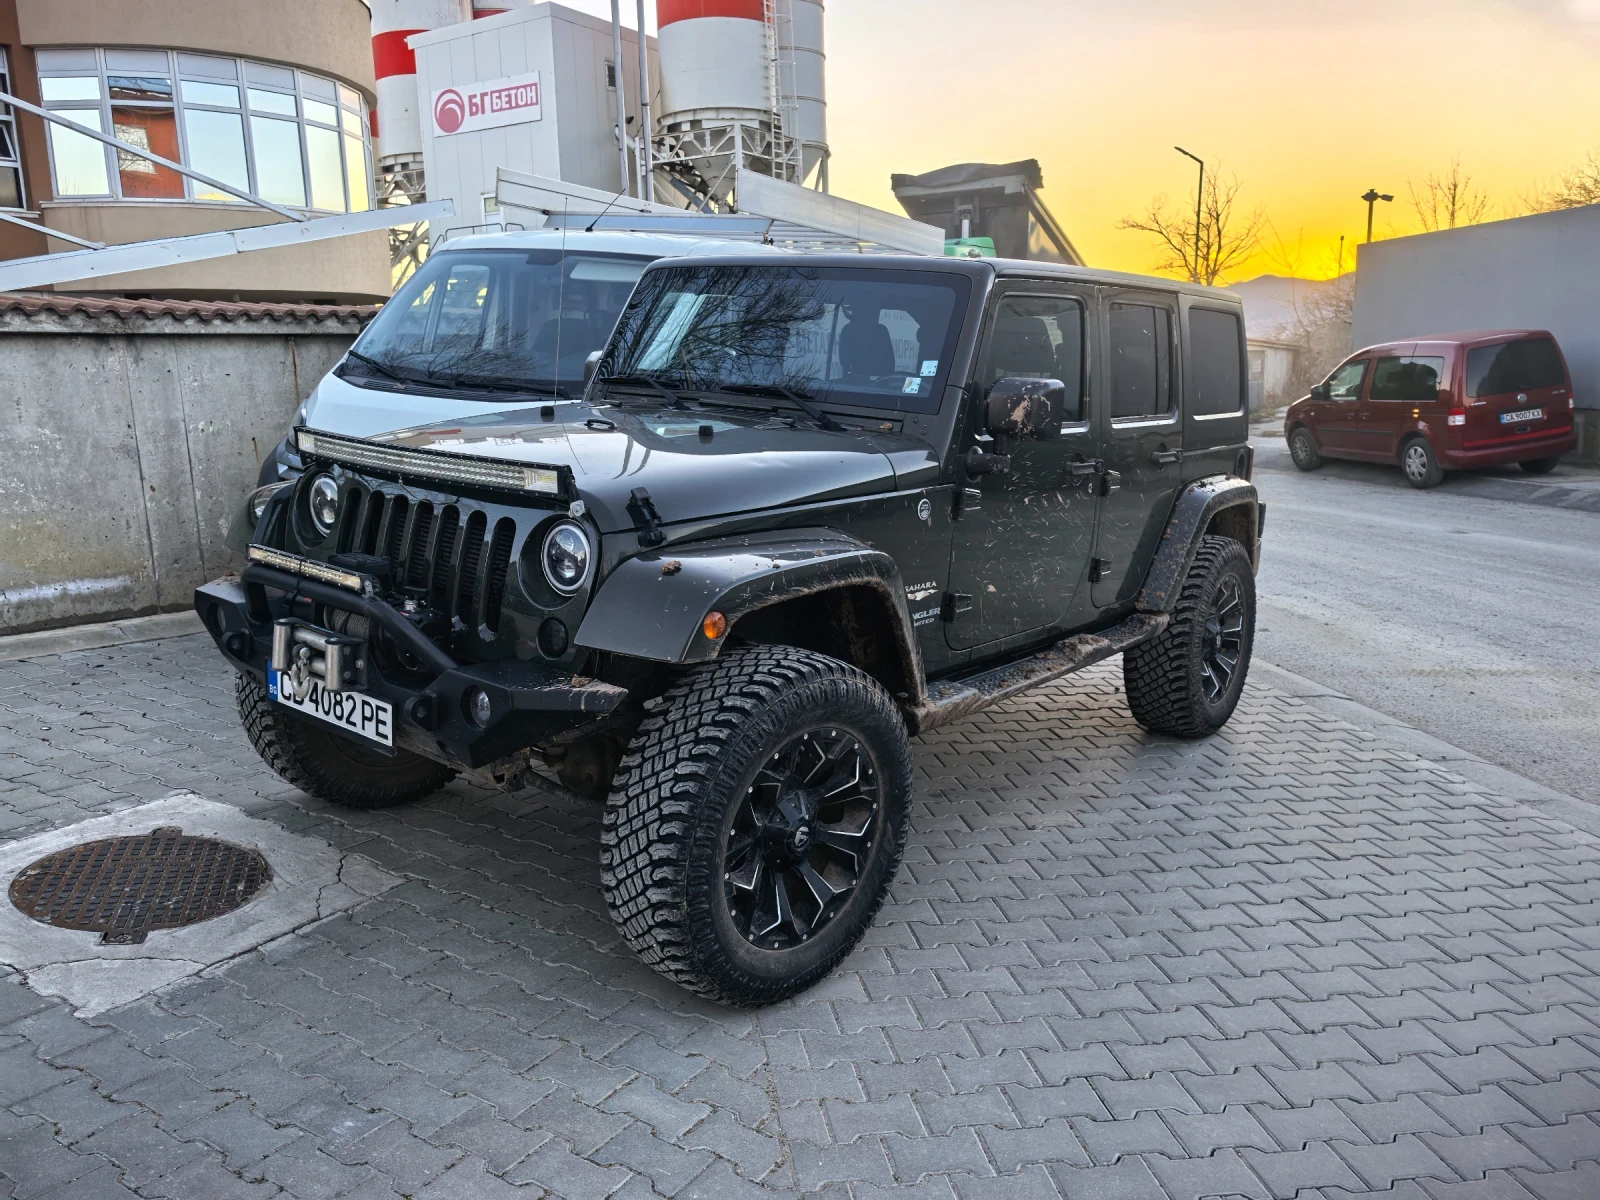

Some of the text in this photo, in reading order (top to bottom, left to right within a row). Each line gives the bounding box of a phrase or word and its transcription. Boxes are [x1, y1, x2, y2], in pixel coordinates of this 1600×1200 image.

[492, 85, 537, 112] БЕТОН
[905, 580, 937, 592] SAHARA
[912, 606, 941, 620] NGLER
[269, 684, 278, 695] BG
